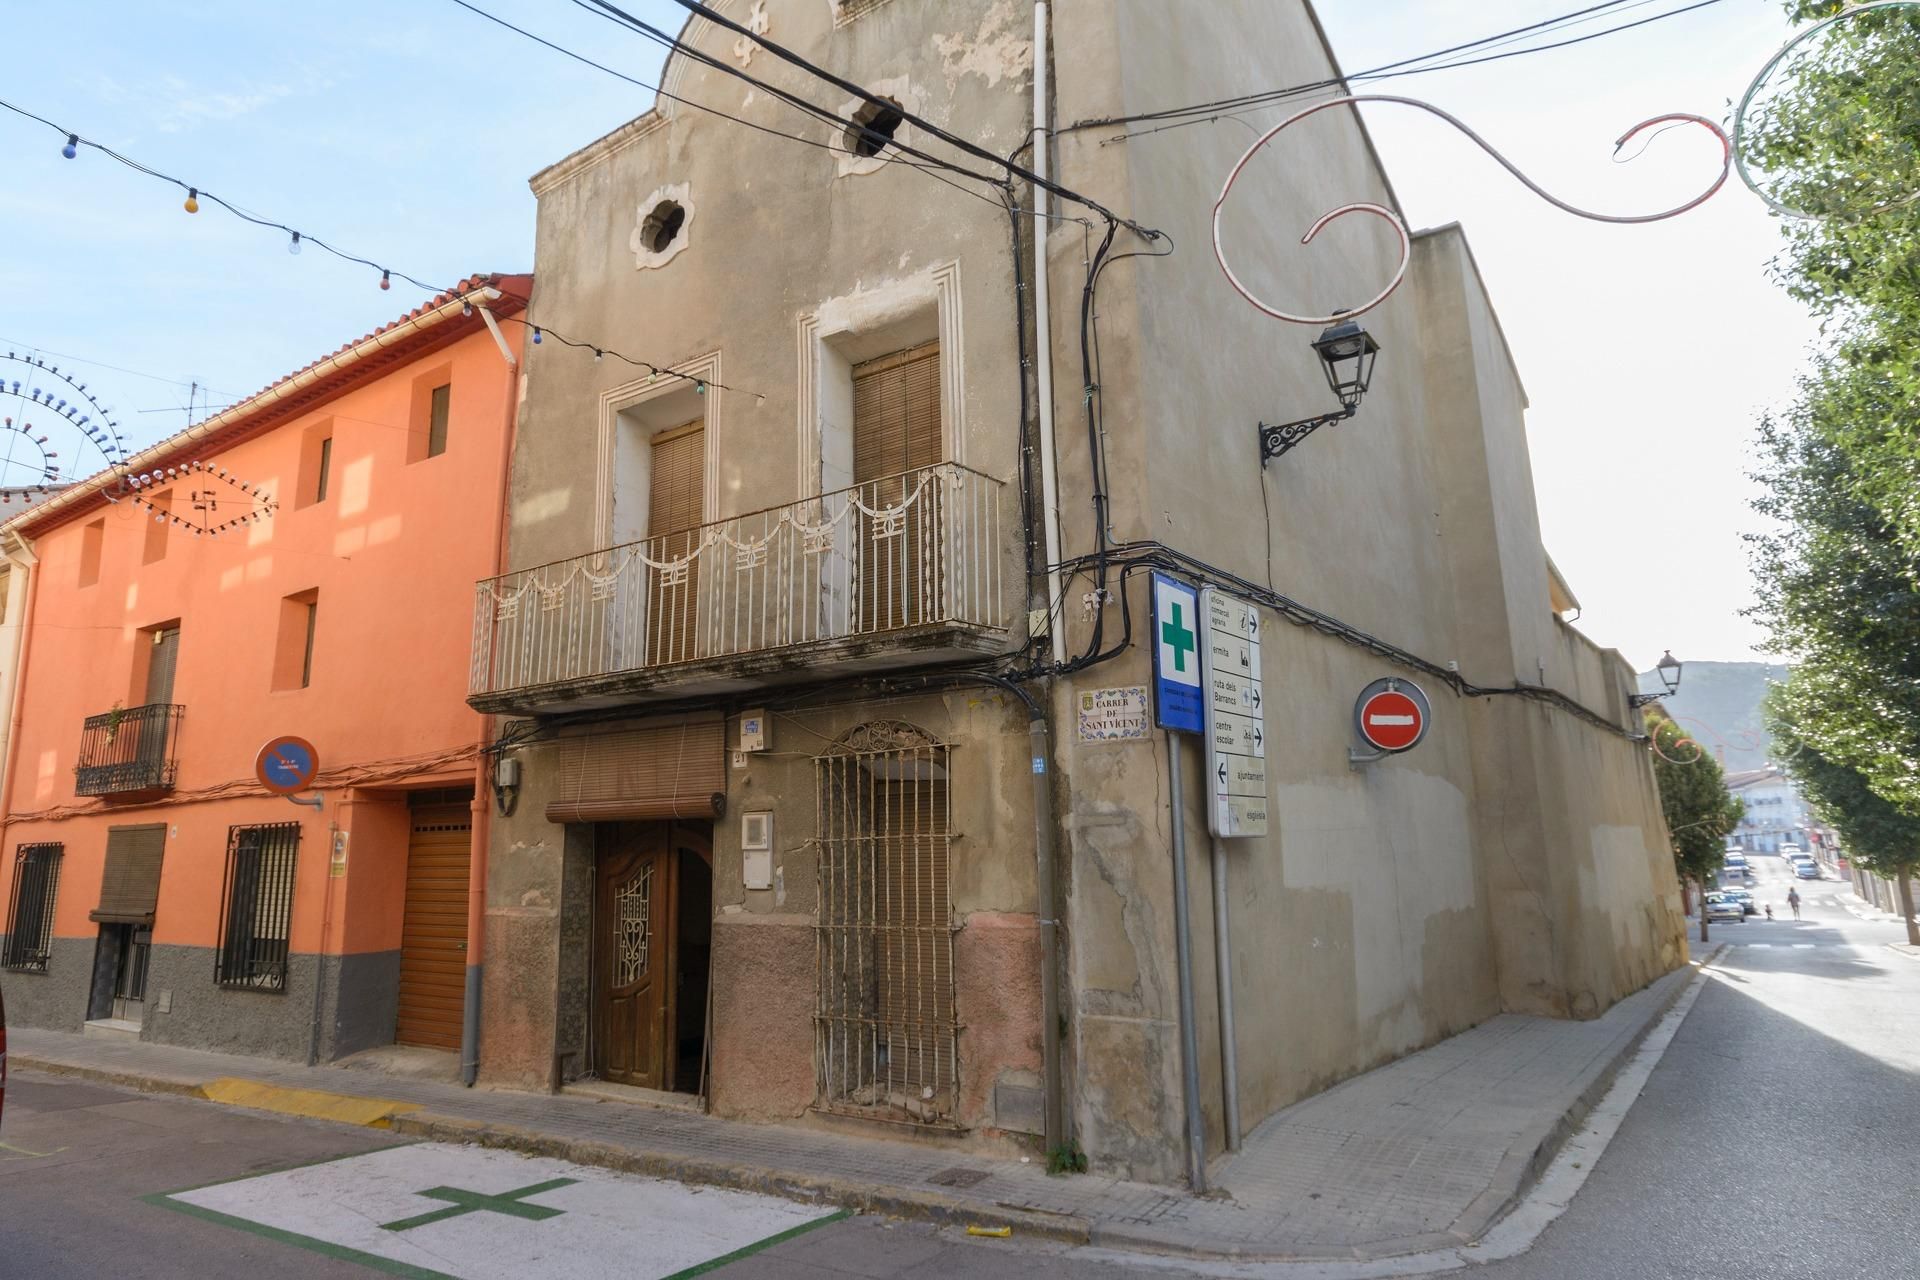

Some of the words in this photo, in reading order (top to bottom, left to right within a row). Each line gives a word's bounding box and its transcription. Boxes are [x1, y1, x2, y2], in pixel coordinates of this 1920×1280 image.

[1213, 646, 1230, 658] ermita
[1214, 680, 1225, 689] ruta
[1225, 681, 1237, 692] dels
[1096, 698, 1129, 708] CARRER
[1214, 691, 1237, 705] Barrancs
[1106, 709, 1118, 718] DE
[1086, 720, 1108, 730] SANT
[1215, 721, 1232, 731] centre
[1216, 735, 1234, 745] escolar
